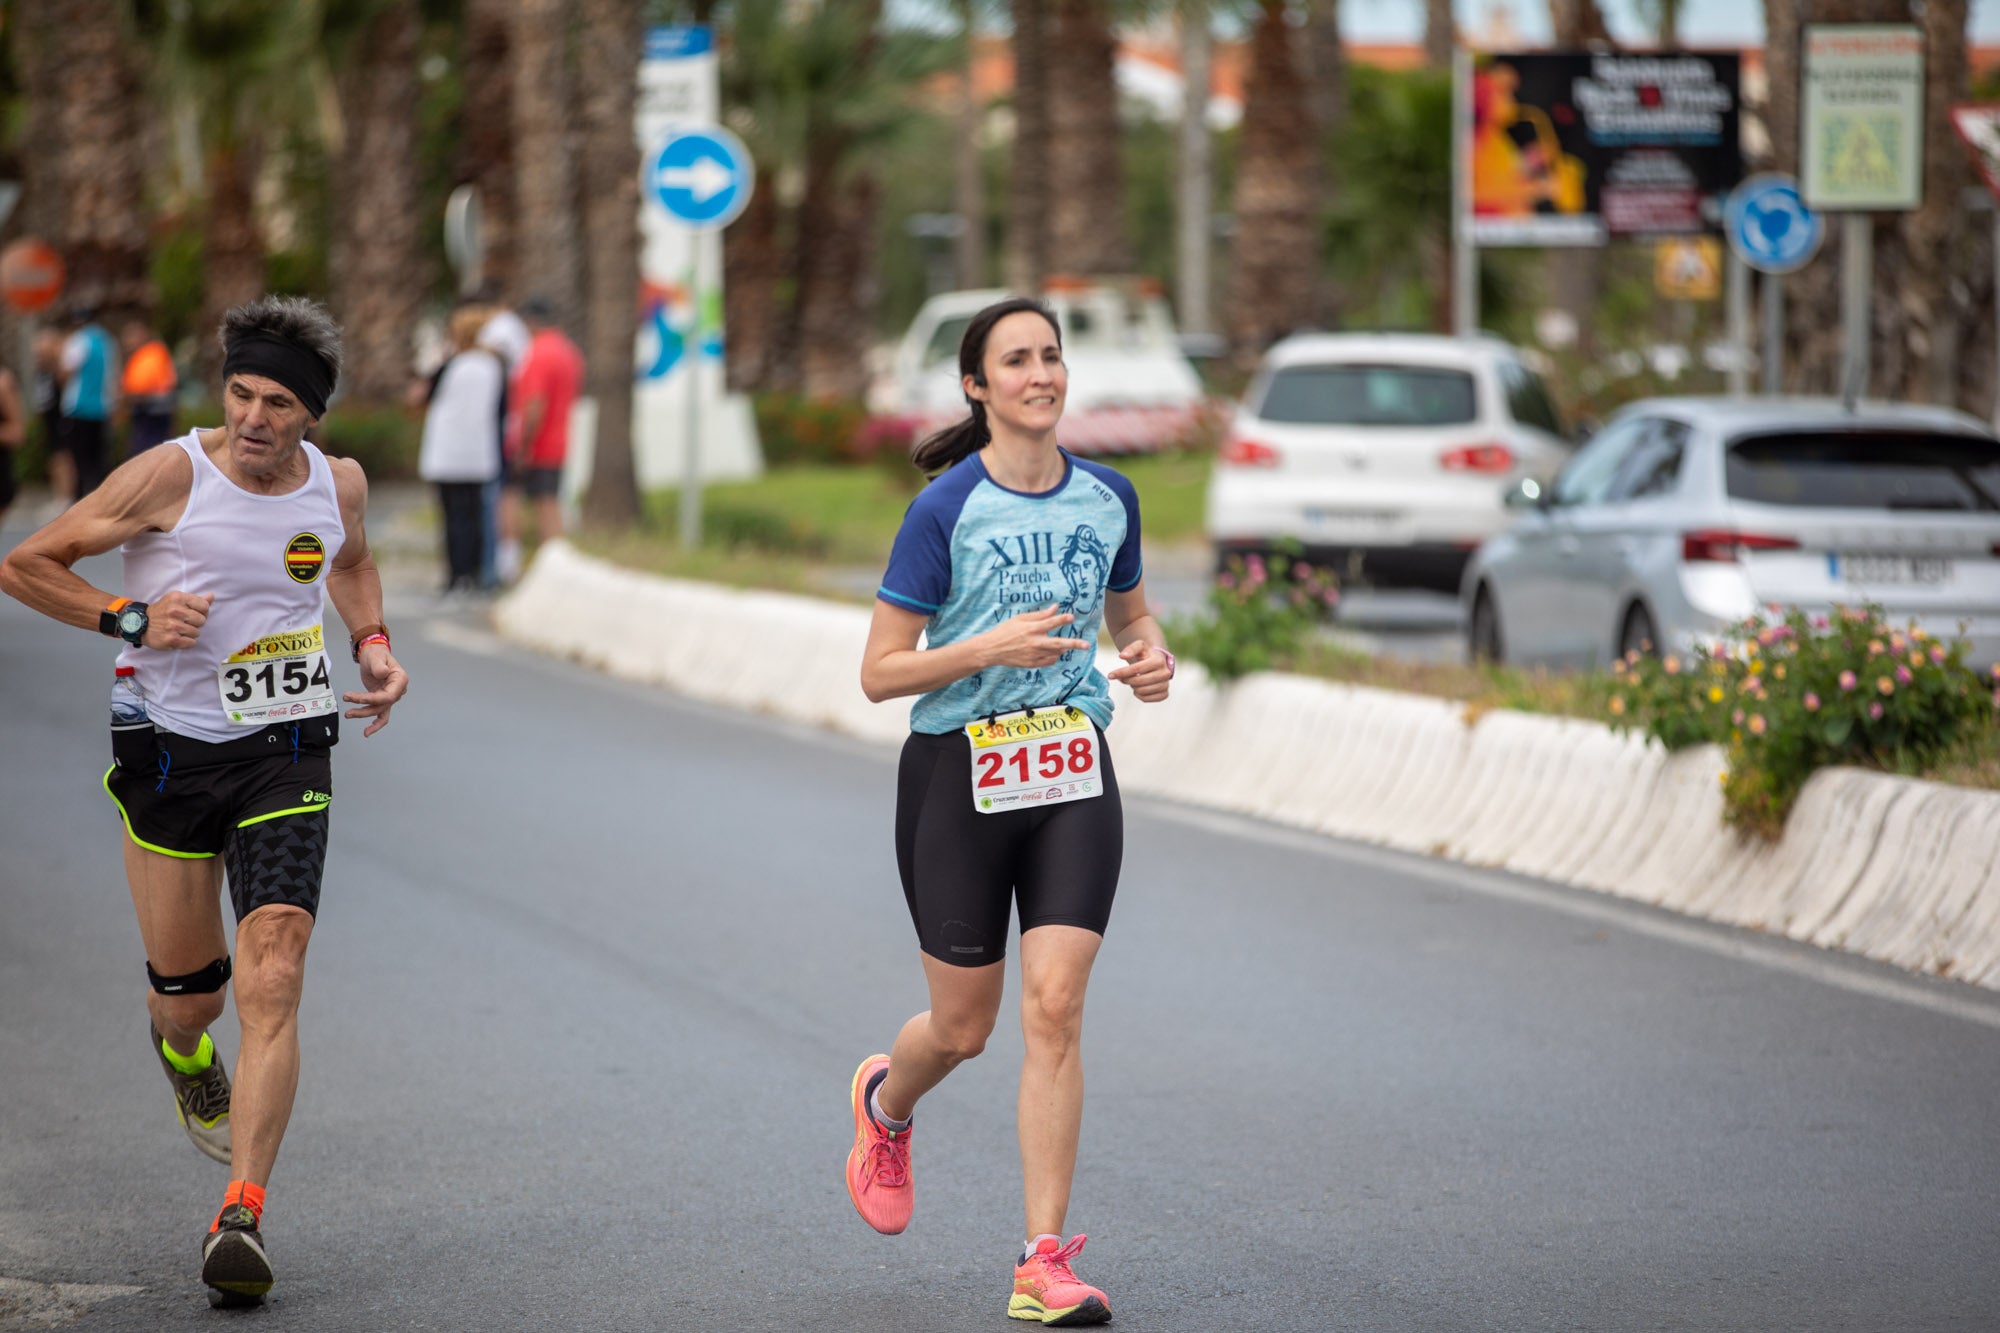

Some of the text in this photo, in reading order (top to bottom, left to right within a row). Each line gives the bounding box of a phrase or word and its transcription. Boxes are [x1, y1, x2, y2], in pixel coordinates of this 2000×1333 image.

[987, 532, 1054, 570] XIII
[999, 567, 1051, 585] Prueba
[999, 585, 1054, 604] Fondo
[256, 637, 313, 655] FONDO
[259, 631, 308, 644] GRAN PREMIO
[224, 655, 330, 703] 3154
[985, 718, 1066, 739] 38 FONDO
[976, 737, 1094, 789] 2158
